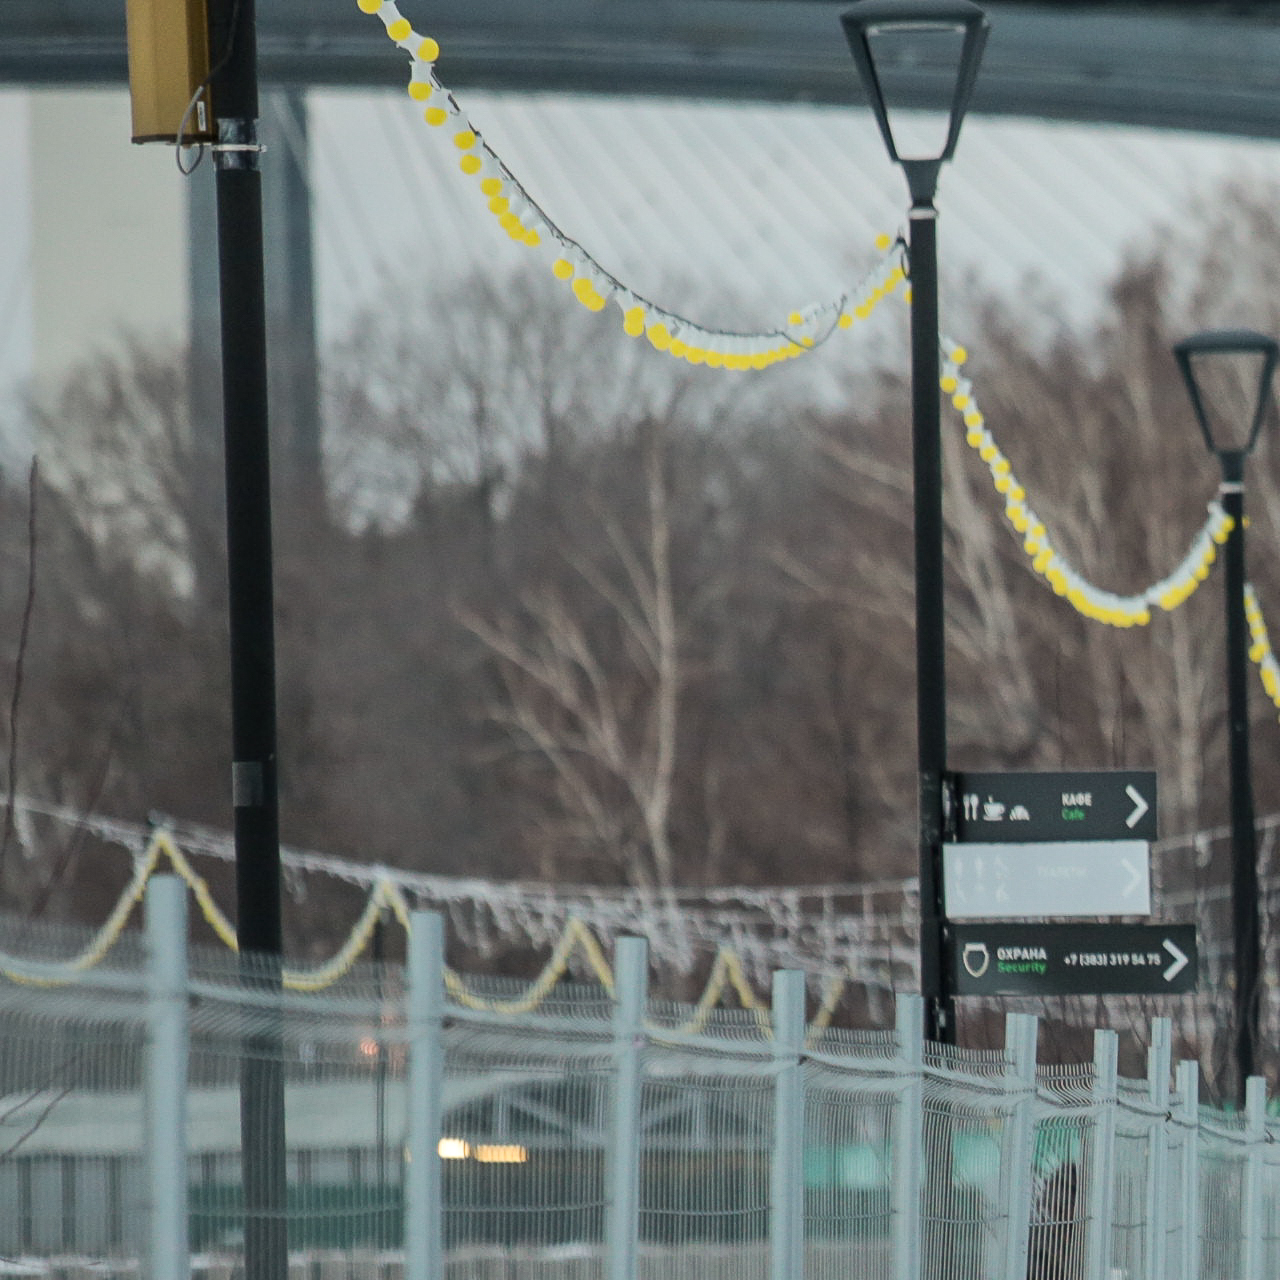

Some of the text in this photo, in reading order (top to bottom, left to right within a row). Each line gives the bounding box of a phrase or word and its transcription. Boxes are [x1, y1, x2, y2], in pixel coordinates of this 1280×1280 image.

[1061, 792, 1092, 807] КАФЕ
[997, 946, 1047, 960] ОХРАНА
[1063, 953, 1077, 966] +7
[1109, 953, 1130, 966] 319
[997, 961, 1047, 975] Security
